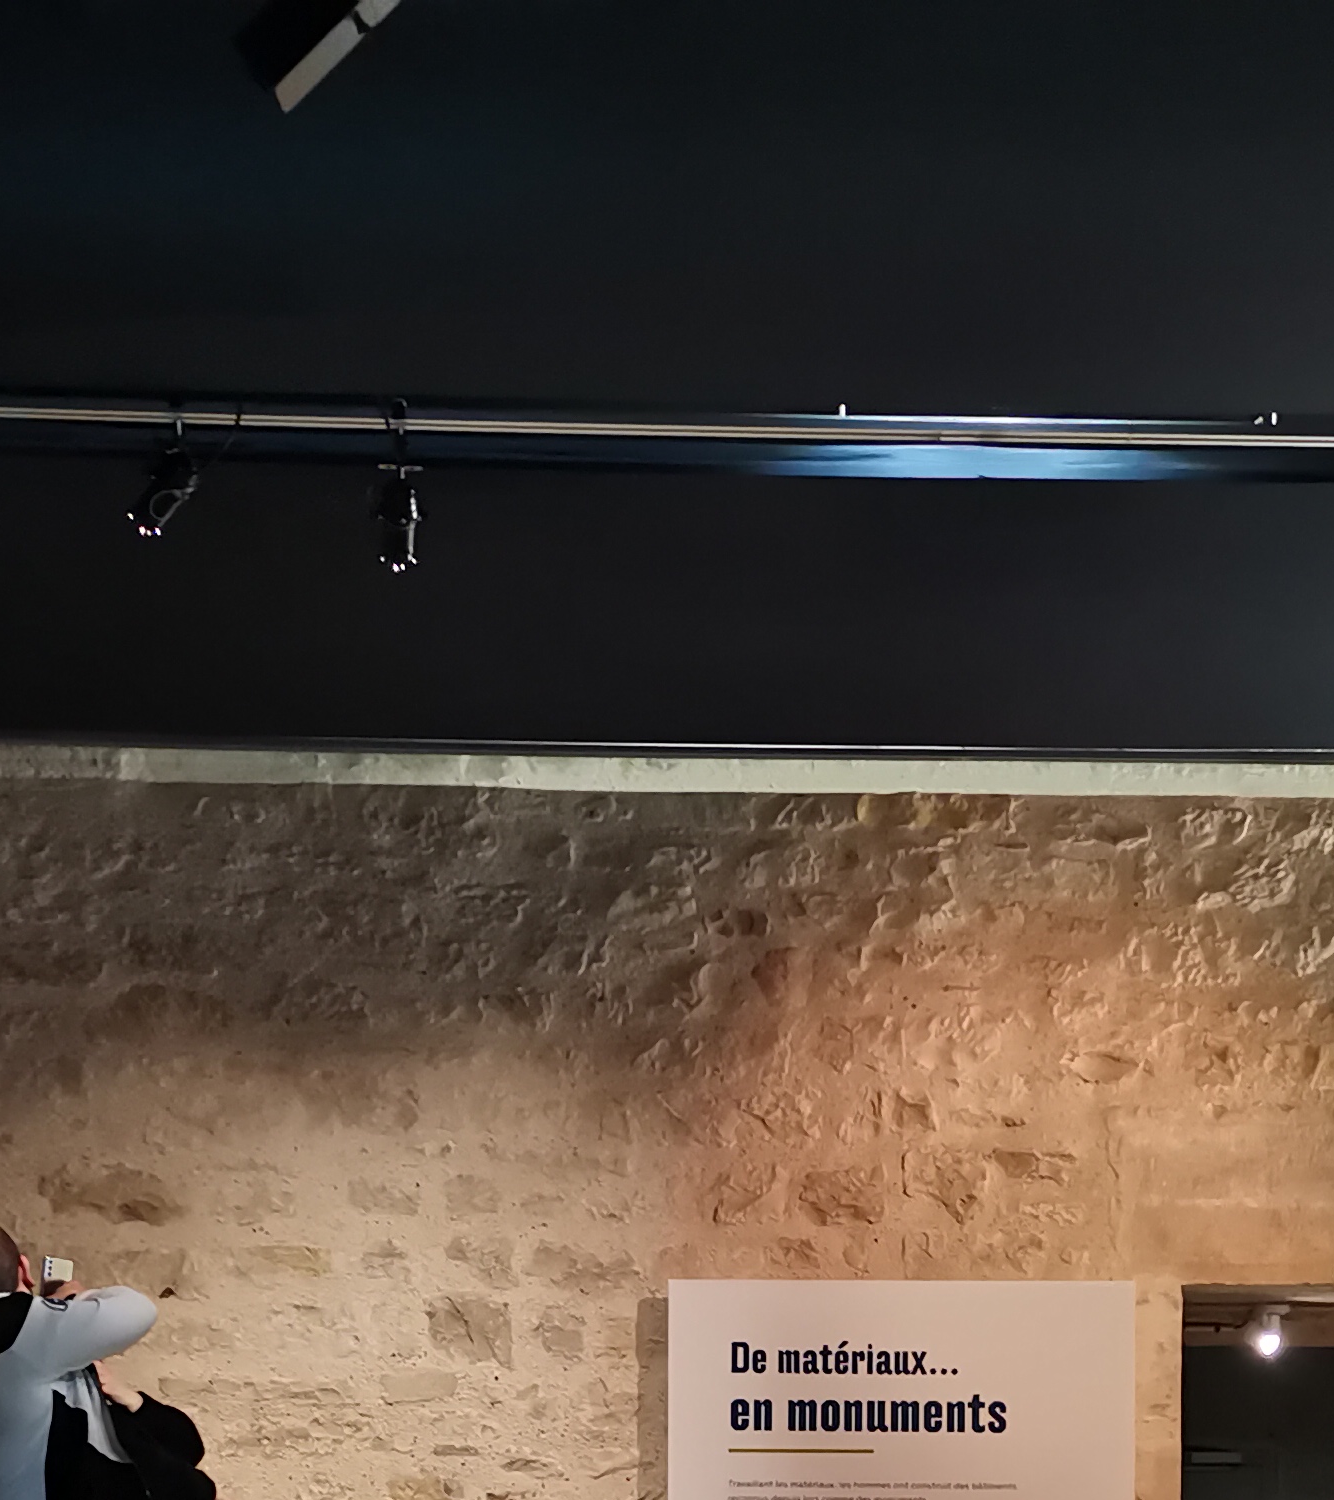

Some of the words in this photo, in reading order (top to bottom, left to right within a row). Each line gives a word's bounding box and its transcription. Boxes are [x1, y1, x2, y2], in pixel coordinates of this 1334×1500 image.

[730, 1341, 767, 1374] De
[777, 1340, 959, 1376] matériaux...
[730, 1398, 773, 1432] en
[787, 1393, 1007, 1434] monuments
